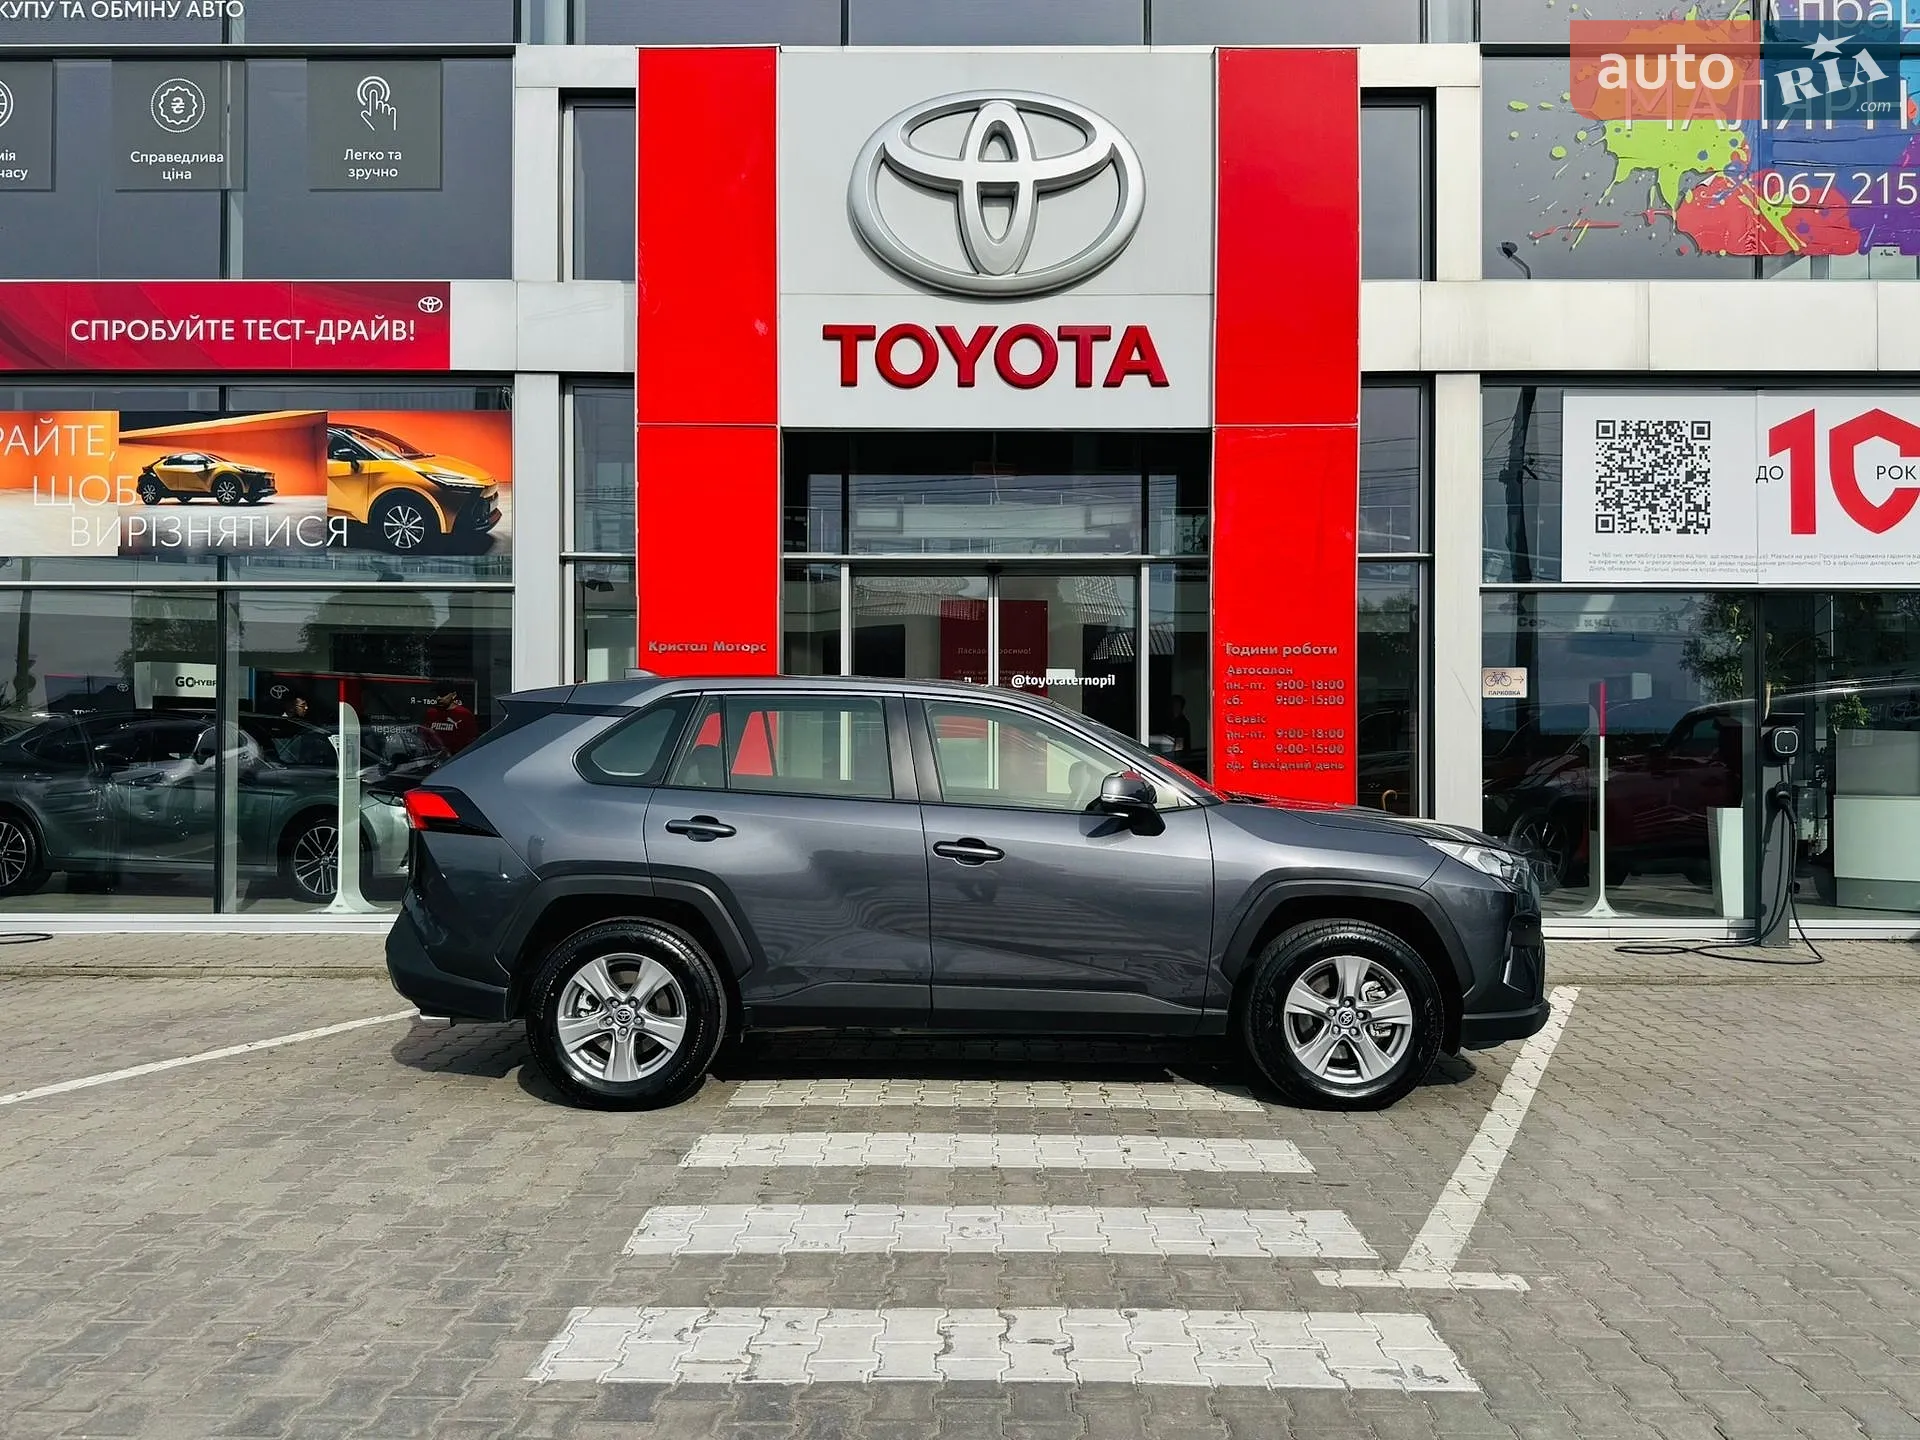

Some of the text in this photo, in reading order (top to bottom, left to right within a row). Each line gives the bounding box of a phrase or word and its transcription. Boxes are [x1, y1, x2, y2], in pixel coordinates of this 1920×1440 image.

[60, 1, 86, 18] ТА
[91, 1, 181, 19] ОБМІНУ
[186, 1, 244, 18] АВТО
[130, 151, 224, 165] Справедлива
[343, 148, 403, 161] Легко та
[162, 168, 192, 181] ціна
[347, 168, 399, 180] зручно
[1762, 172, 1918, 206] 067 215
[71, 315, 416, 345] СПРОБУЙТЕ ТЕСТ-ДРАЙВ!
[822, 323, 1170, 389] TOYOTA
[1755, 465, 1784, 483] ДО
[1876, 465, 1917, 480] РОК
[32, 475, 136, 509] ЩОБ
[71, 515, 348, 547] ВИРІЗНЯТИСЯ
[648, 641, 767, 653] Кристал Моторс
[1226, 642, 1338, 657] Години роботи
[1227, 665, 1293, 675] Автосалон
[1011, 674, 1116, 688] @toyotaternopil
[1226, 695, 1243, 705] сб.
